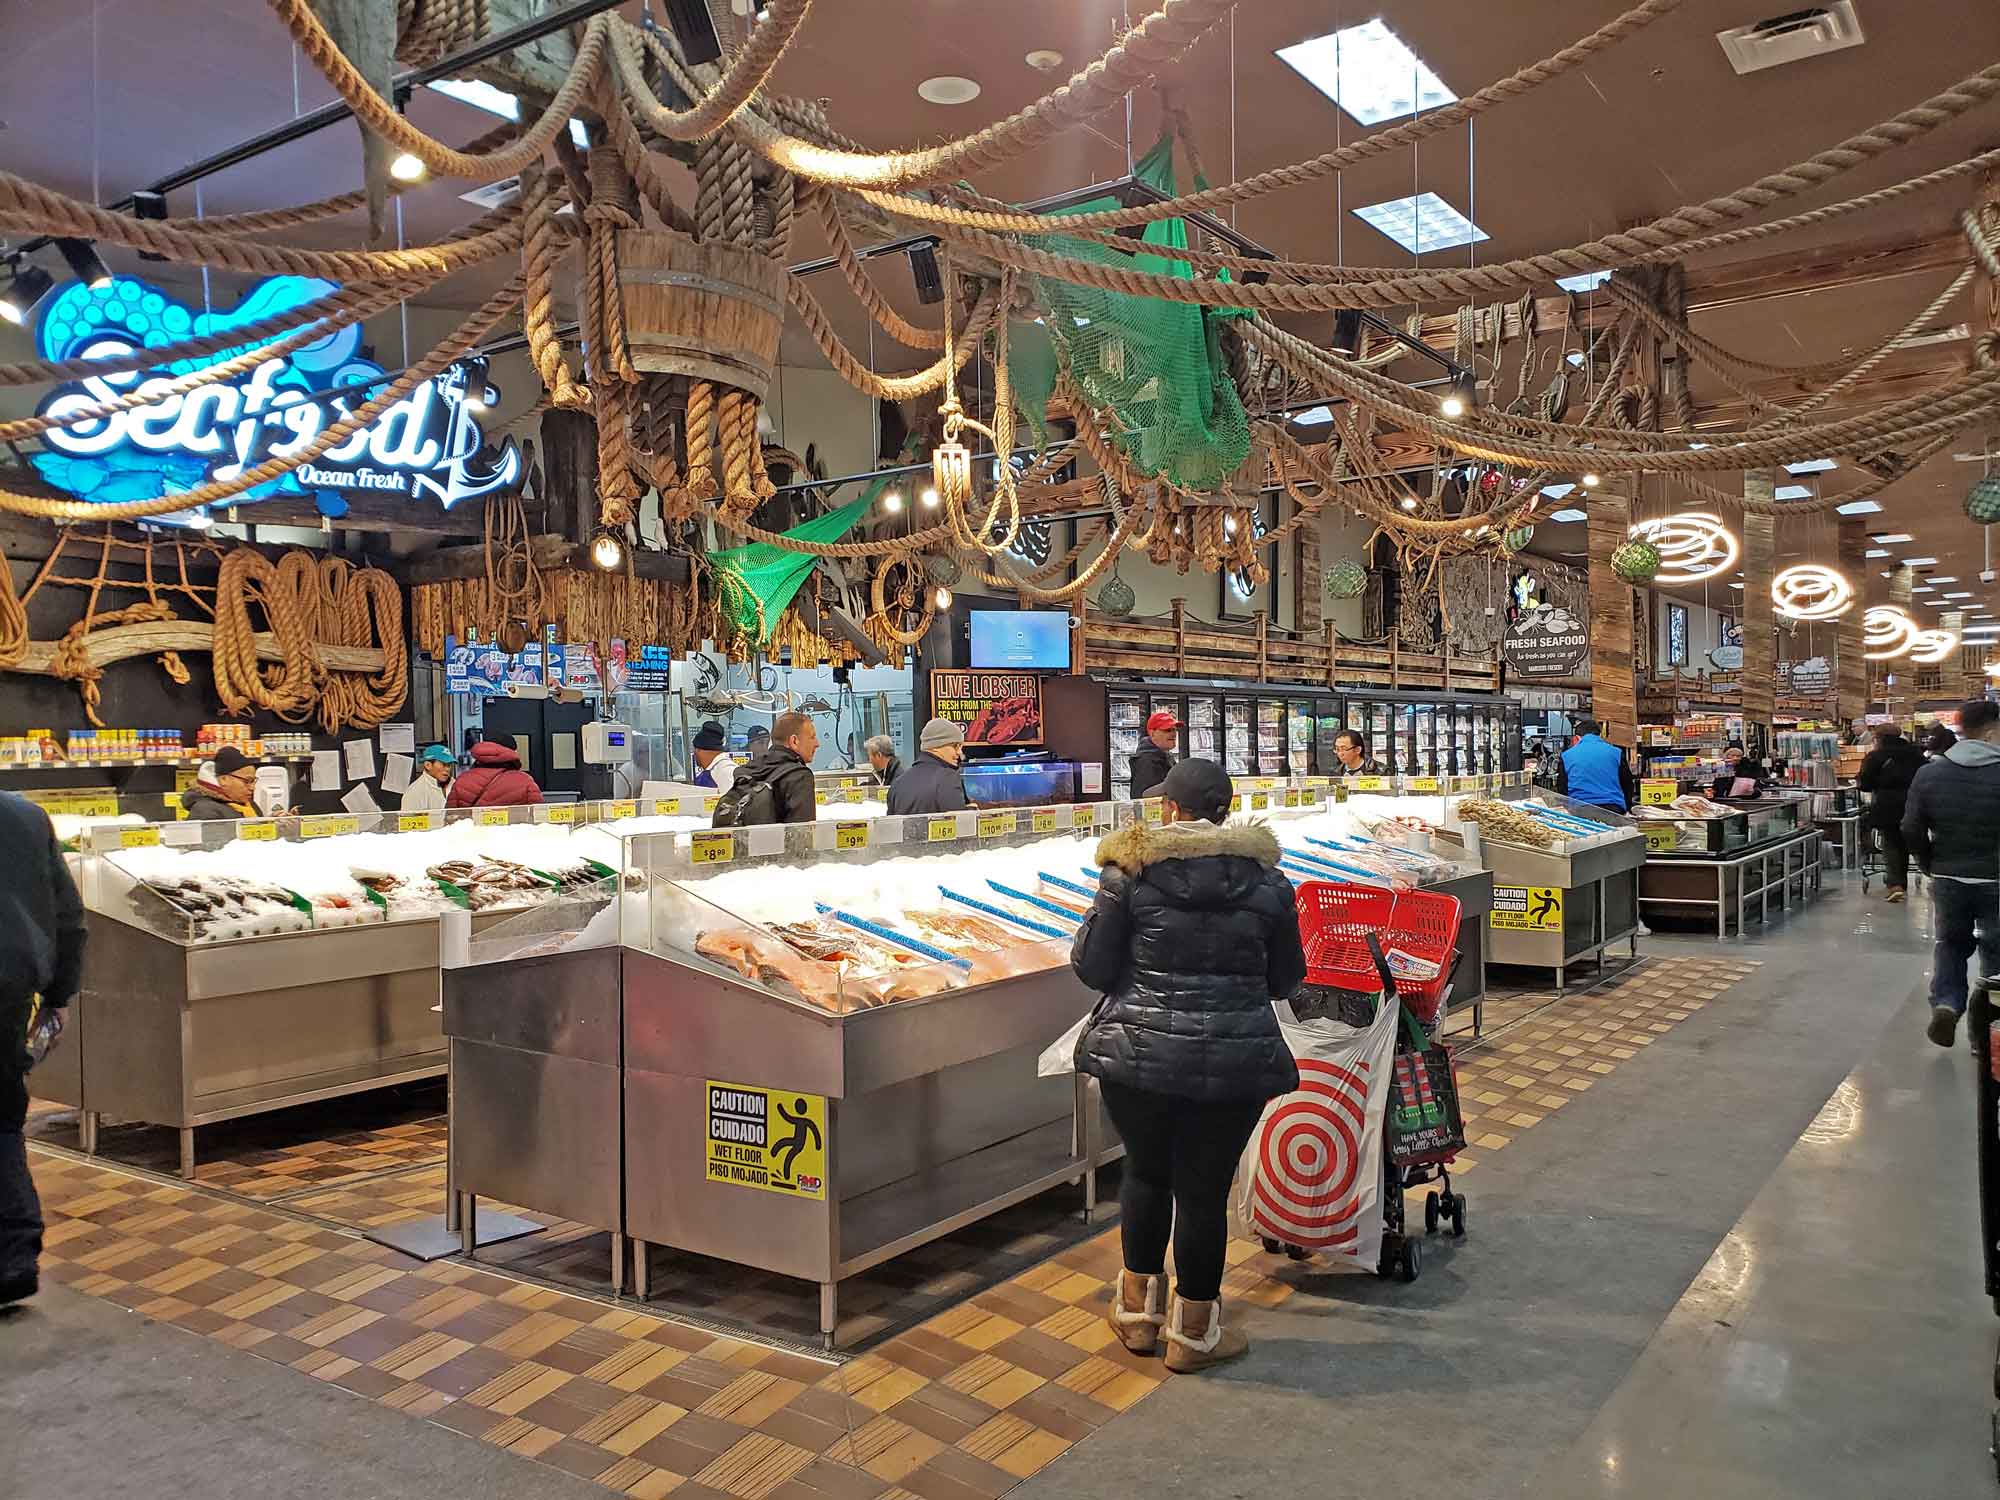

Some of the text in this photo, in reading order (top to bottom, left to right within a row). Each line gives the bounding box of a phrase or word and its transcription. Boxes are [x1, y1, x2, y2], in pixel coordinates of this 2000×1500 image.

[297, 464, 405, 490] Ocean Fresh
[1505, 634, 1586, 650] FRESH SEAFOOD
[1517, 652, 1524, 660] As
[1546, 652, 1556, 661] you
[625, 660, 668, 670] STEAMING
[937, 675, 1037, 698] LIVE LOBSTER
[938, 700, 993, 710] FRESH FROM THE
[938, 710, 952, 720] SEA
[953, 710, 961, 720] TO
[1493, 888, 1526, 899] CAUTION
[1493, 901, 1526, 911] CUIDADO
[711, 1089, 765, 1116] CAUTION
[711, 1118, 765, 1145] CUIDADO
[1400, 1132, 1417, 1143] HAVE
[714, 1143, 762, 1164] WET FLOOR
[709, 1162, 768, 1185] PISO MOJADO
